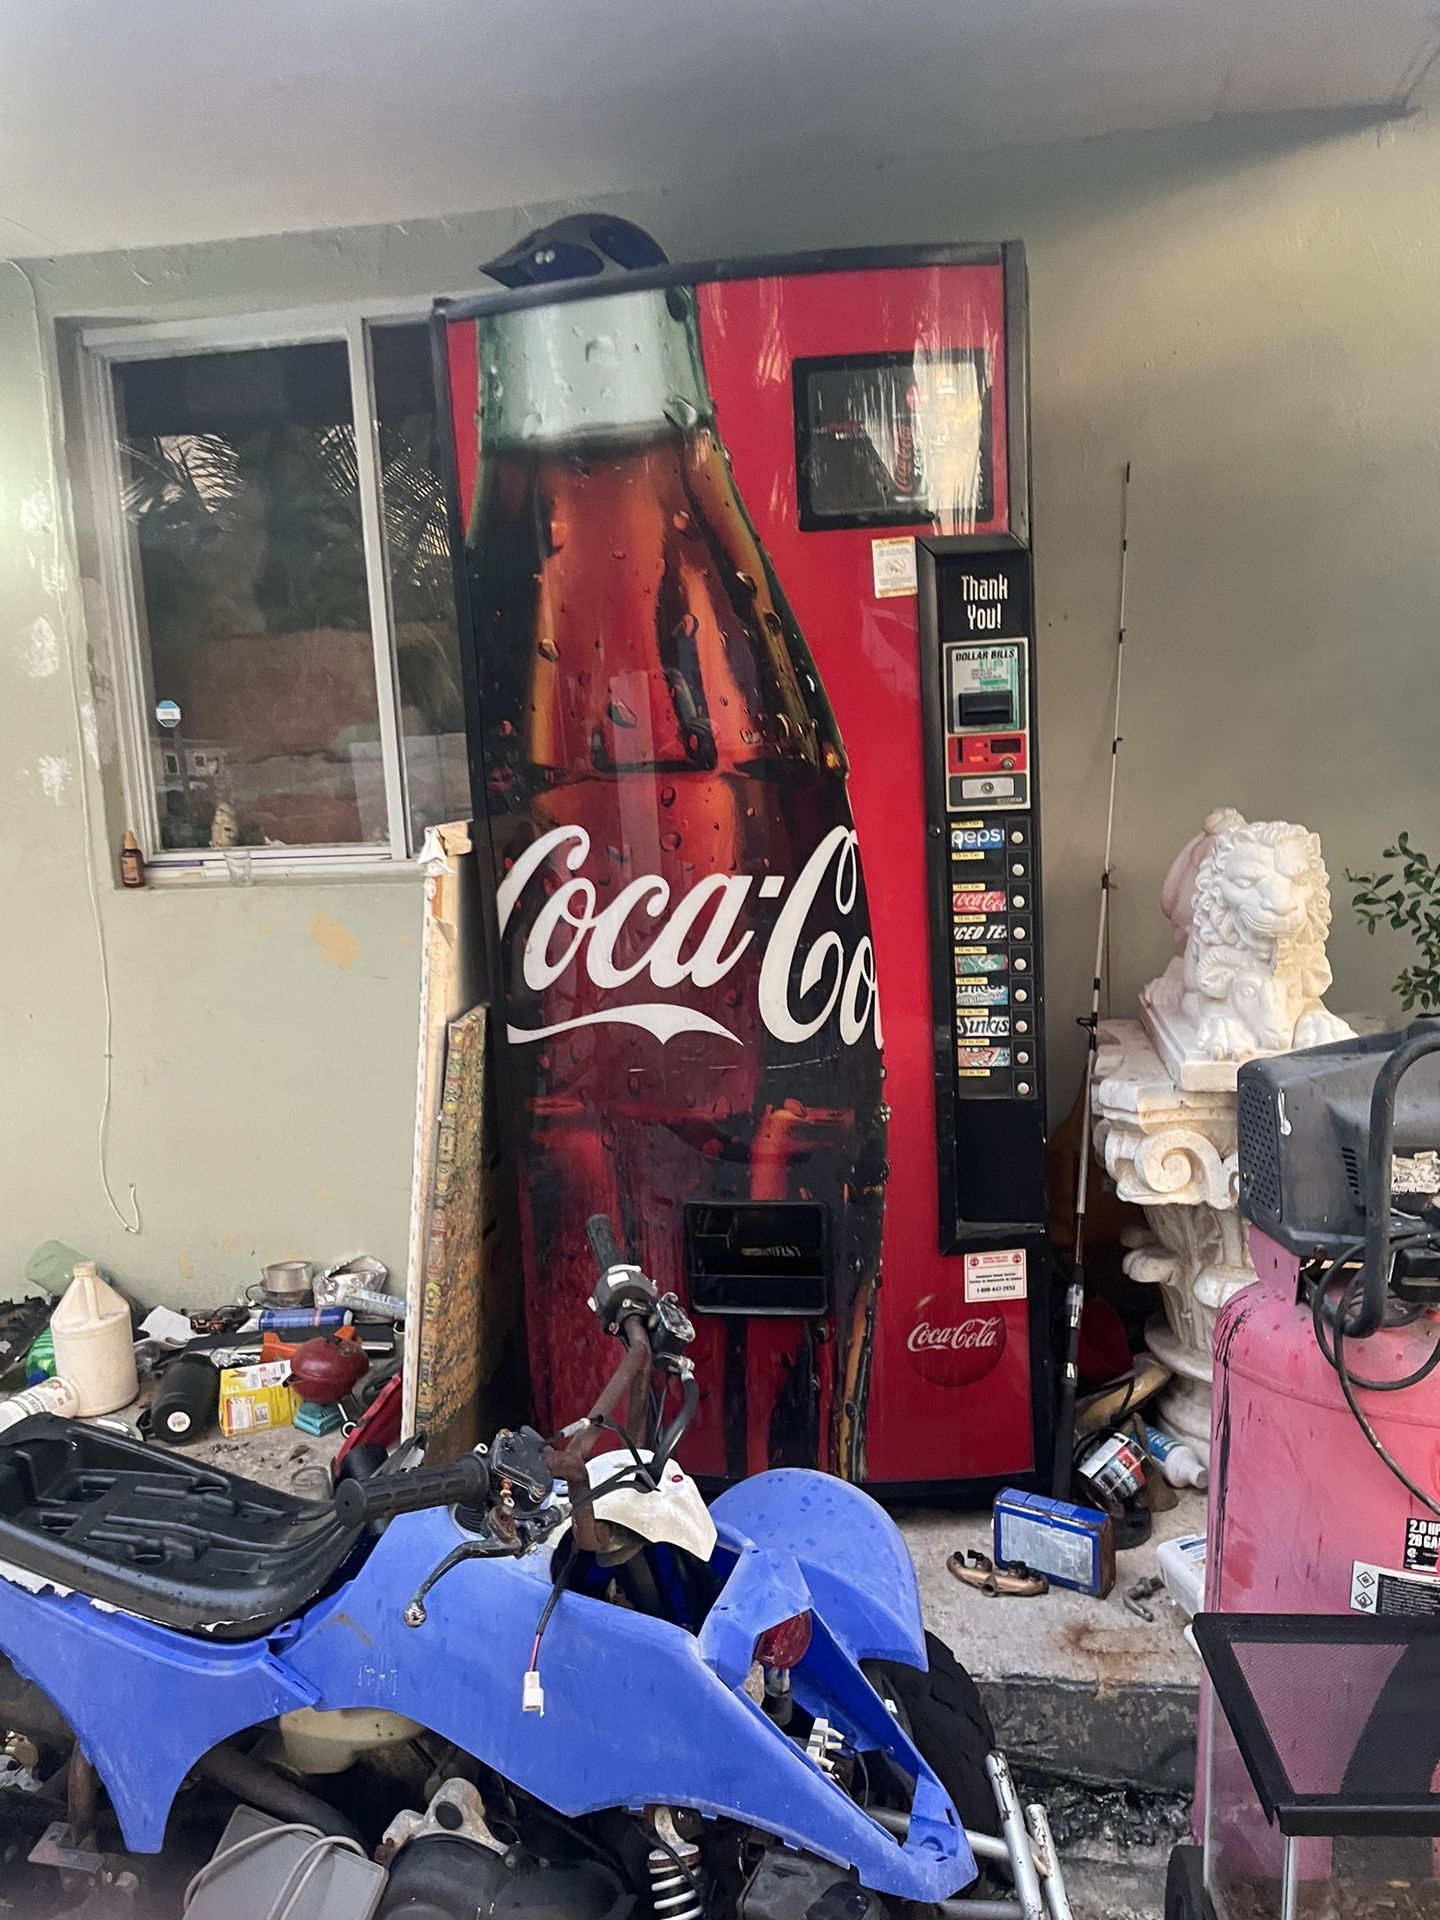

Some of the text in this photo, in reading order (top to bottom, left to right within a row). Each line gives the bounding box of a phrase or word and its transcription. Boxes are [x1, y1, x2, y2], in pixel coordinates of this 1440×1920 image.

[961, 573, 1009, 601] Thank
[967, 603, 1002, 630] You!
[956, 648, 1015, 662] DOLLAR BILLS
[496, 824, 883, 1049] Coca-Co
[907, 1316, 1001, 1352] Coca-Cola
[1409, 1519, 1427, 1534] 2.0
[1423, 1535, 1440, 1549] GA
